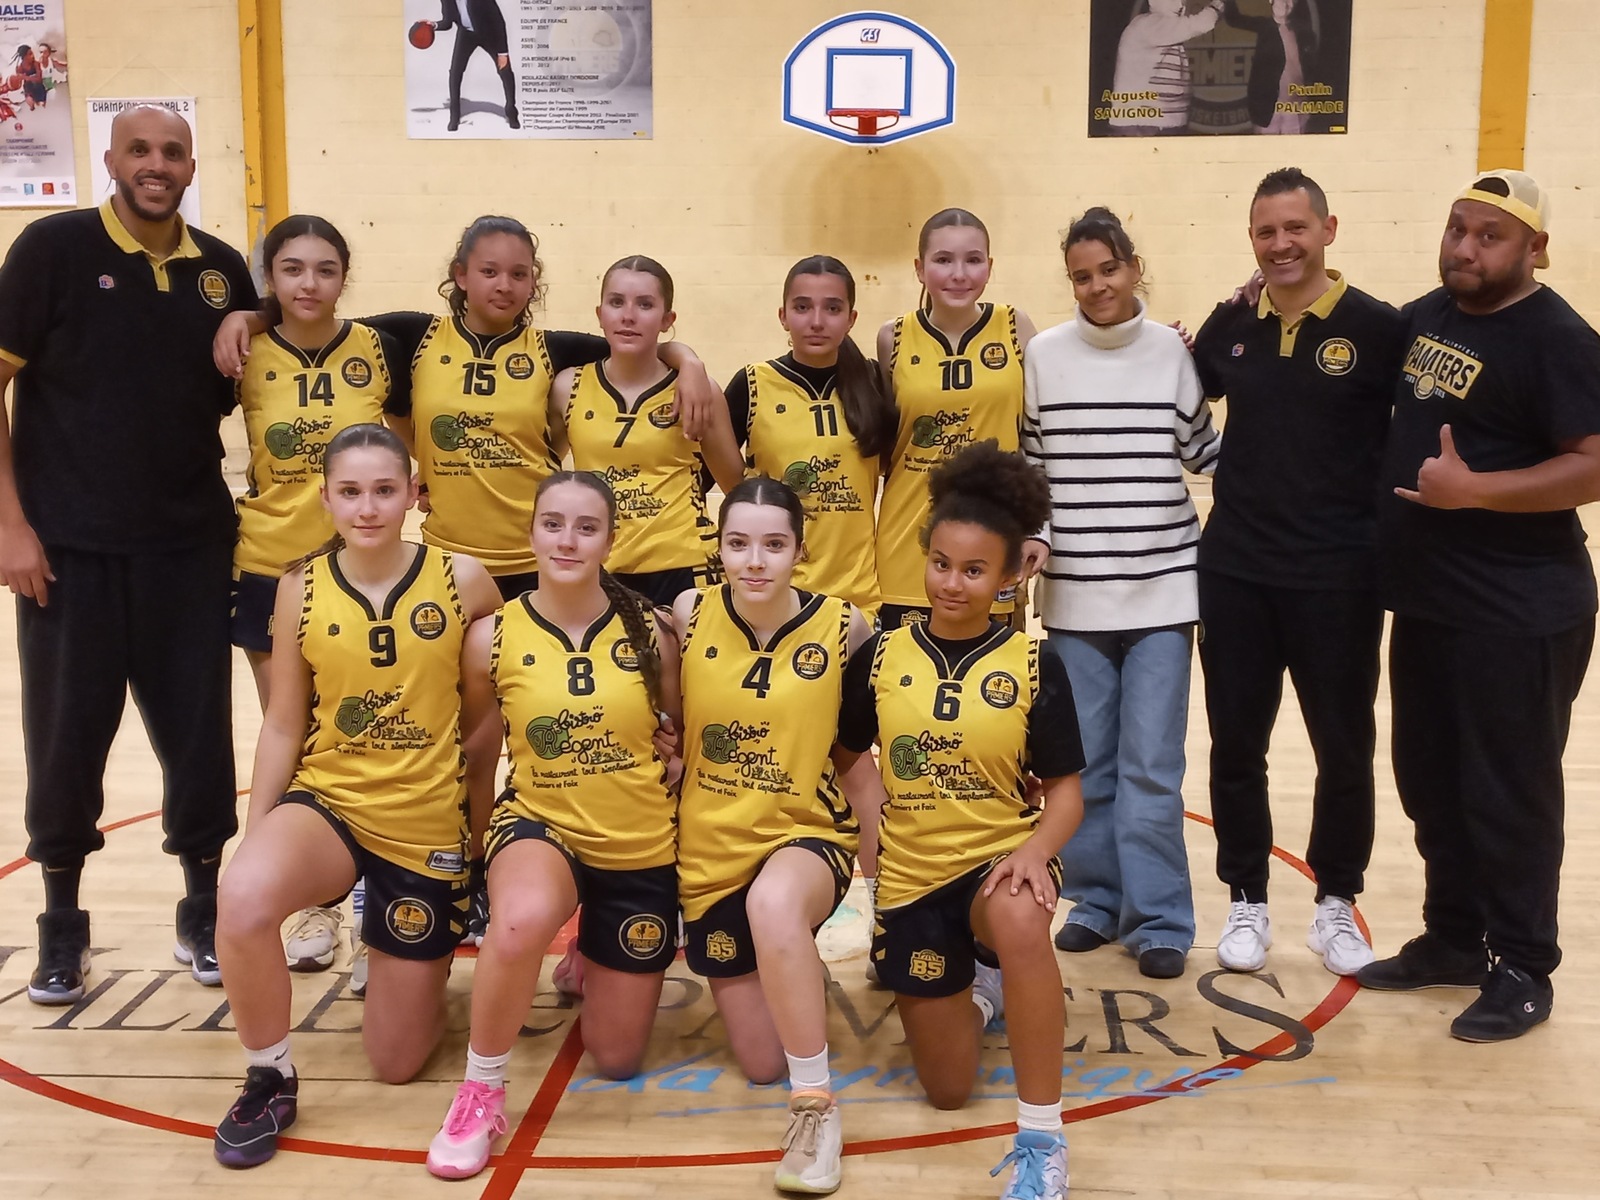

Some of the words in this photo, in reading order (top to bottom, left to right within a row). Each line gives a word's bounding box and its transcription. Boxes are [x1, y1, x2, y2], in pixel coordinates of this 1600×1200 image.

[1102, 90, 1158, 103] Auguste
[1288, 82, 1332, 96] Paulin
[183, 102, 189, 111] 2
[1094, 107, 1164, 120] SAVIGNOL
[1275, 102, 1344, 114] PALMADE
[293, 372, 335, 408] 14
[462, 362, 497, 396] 15
[938, 359, 973, 391] 10
[613, 417, 637, 448] 7
[809, 404, 838, 437] 11
[369, 625, 397, 668] 9
[566, 657, 596, 696] 8
[741, 656, 773, 699] 4
[932, 682, 962, 722] 6
[558, 709, 604, 730] bistro
[728, 720, 770, 741] bistro
[918, 730, 963, 752] bistro
